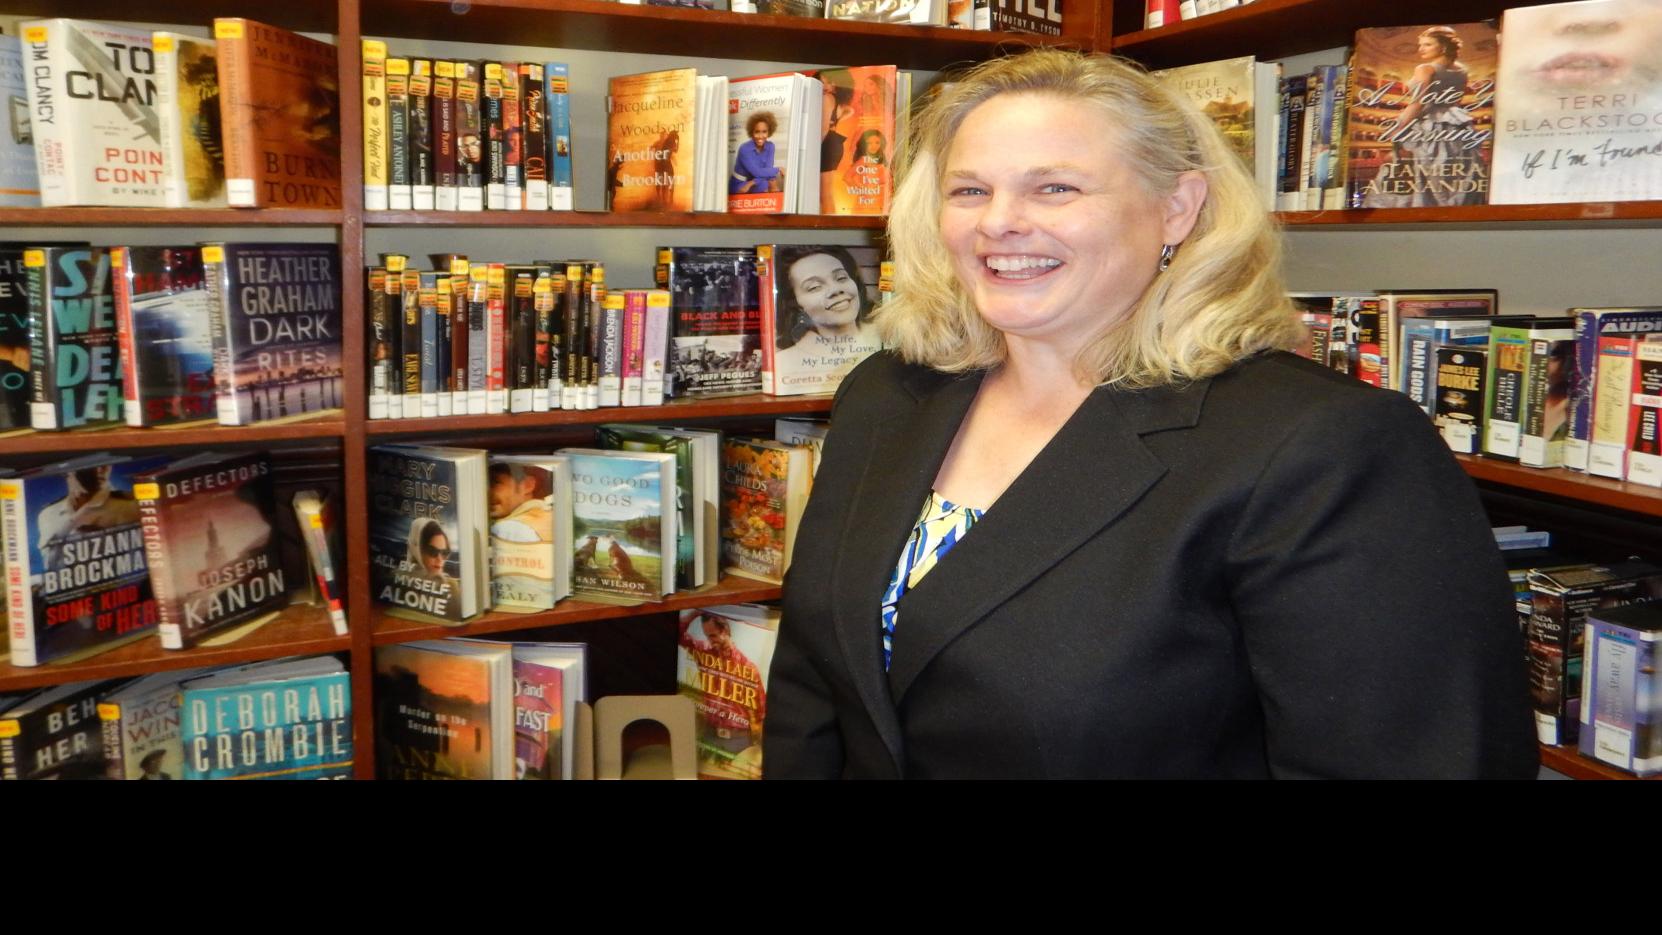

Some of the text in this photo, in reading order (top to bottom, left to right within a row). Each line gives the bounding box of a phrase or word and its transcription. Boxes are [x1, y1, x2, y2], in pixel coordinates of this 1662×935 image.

[34, 66, 54, 125] CLANCY
[740, 96, 786, 111] Differently
[1390, 80, 1464, 105] Note
[1557, 94, 1638, 110] TERRI
[612, 96, 683, 115] Jacqueline
[392, 110, 403, 143] ASHLEY
[620, 121, 685, 137] Woodson
[1377, 119, 1491, 149] Unsung
[264, 151, 335, 180] BURN
[612, 148, 669, 164] Another
[863, 155, 879, 164] The
[1521, 150, 1546, 178] If
[622, 172, 686, 189] Brooklyn
[855, 164, 877, 175] One
[1385, 163, 1487, 179] TAMERA
[264, 180, 340, 207] TOWN
[846, 185, 880, 196] Waited
[858, 196, 874, 205] For
[238, 257, 331, 284] HEATHER
[241, 285, 334, 315] GRAHAM
[681, 312, 718, 321] BLACK
[721, 311, 746, 319] AND
[250, 315, 332, 345] DARK
[815, 335, 832, 345] My
[604, 310, 615, 373] BRENDA JACKSON
[258, 347, 327, 371] RITES
[802, 356, 858, 367] My Legacy
[1439, 364, 1480, 376] JAMES LEE
[699, 371, 755, 381] JEFF PEGUES
[782, 376, 822, 385] Coretta
[1410, 340, 1426, 403] RAIN GODS
[1438, 373, 1479, 391] BURKE
[727, 456, 762, 475] LAURA
[166, 461, 269, 499] DEFECTORS
[600, 475, 650, 489] GOOD
[725, 470, 768, 491] CHILDS
[575, 491, 632, 507] DOGS
[63, 527, 142, 565] SUZANN
[44, 550, 145, 594] BROCKMA
[202, 554, 268, 589] JOSEPH
[398, 561, 417, 573] BY
[395, 575, 452, 600] MYSELF,
[601, 578, 645, 590] WILSON
[47, 585, 139, 626] SOME KIND
[183, 569, 284, 629] KANON
[380, 585, 447, 615] ALONE
[726, 660, 760, 683] LAEL
[523, 684, 544, 698] and
[686, 667, 757, 710] MILLER
[192, 683, 345, 735] DEBORAH
[399, 704, 467, 726] Murder on the
[515, 707, 551, 732] FAST
[728, 711, 750, 727] Hero
[408, 719, 459, 739] Serpentine
[36, 732, 88, 770] HER
[193, 718, 347, 772] CROMBIE
